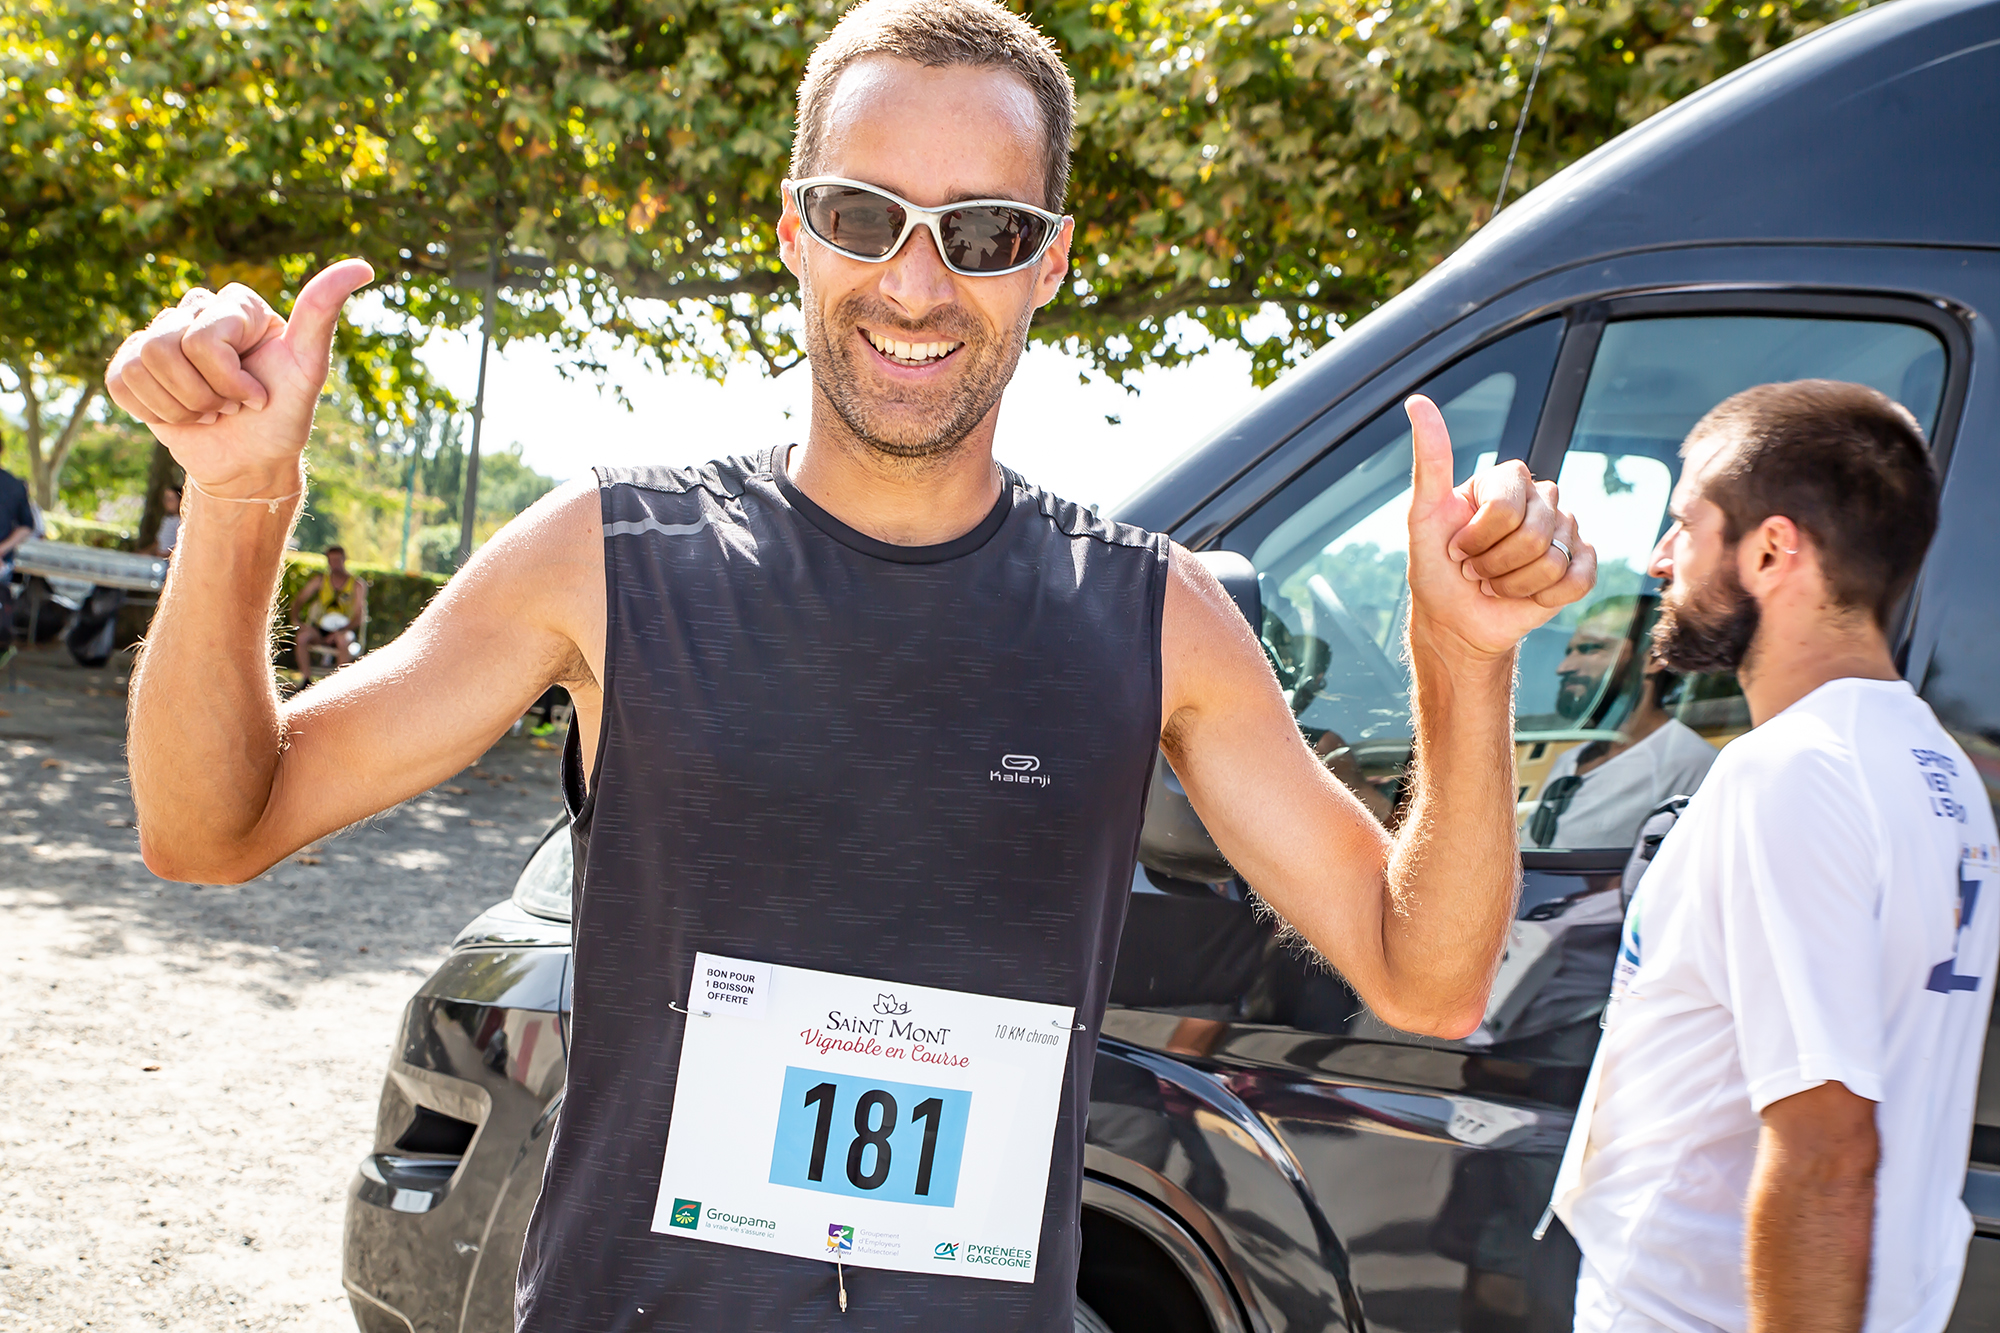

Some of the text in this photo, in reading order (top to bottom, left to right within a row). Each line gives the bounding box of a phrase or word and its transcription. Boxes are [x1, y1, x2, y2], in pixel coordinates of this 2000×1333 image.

[990, 770, 1051, 788] Kalenji
[707, 968, 756, 983] BON POUR
[705, 980, 755, 995] 1 BOISSON
[707, 991, 749, 1005] OFFERTE
[995, 1024, 1059, 1046] 10 KM chrono
[800, 1028, 970, 1068] Vignoble en Course
[803, 1082, 944, 1197] 181
[706, 1208, 777, 1230] Groupama
[713, 1223, 728, 1231] vraie
[730, 1225, 740, 1233] vie
[740, 1228, 766, 1237] s'assure
[767, 1231, 775, 1239] ici
[860, 1228, 900, 1239] Groupement
[859, 1238, 901, 1248] d'Employeurs
[967, 1244, 1032, 1259] PYRÉNÉES
[966, 1254, 1031, 1268] GASCOGNE
